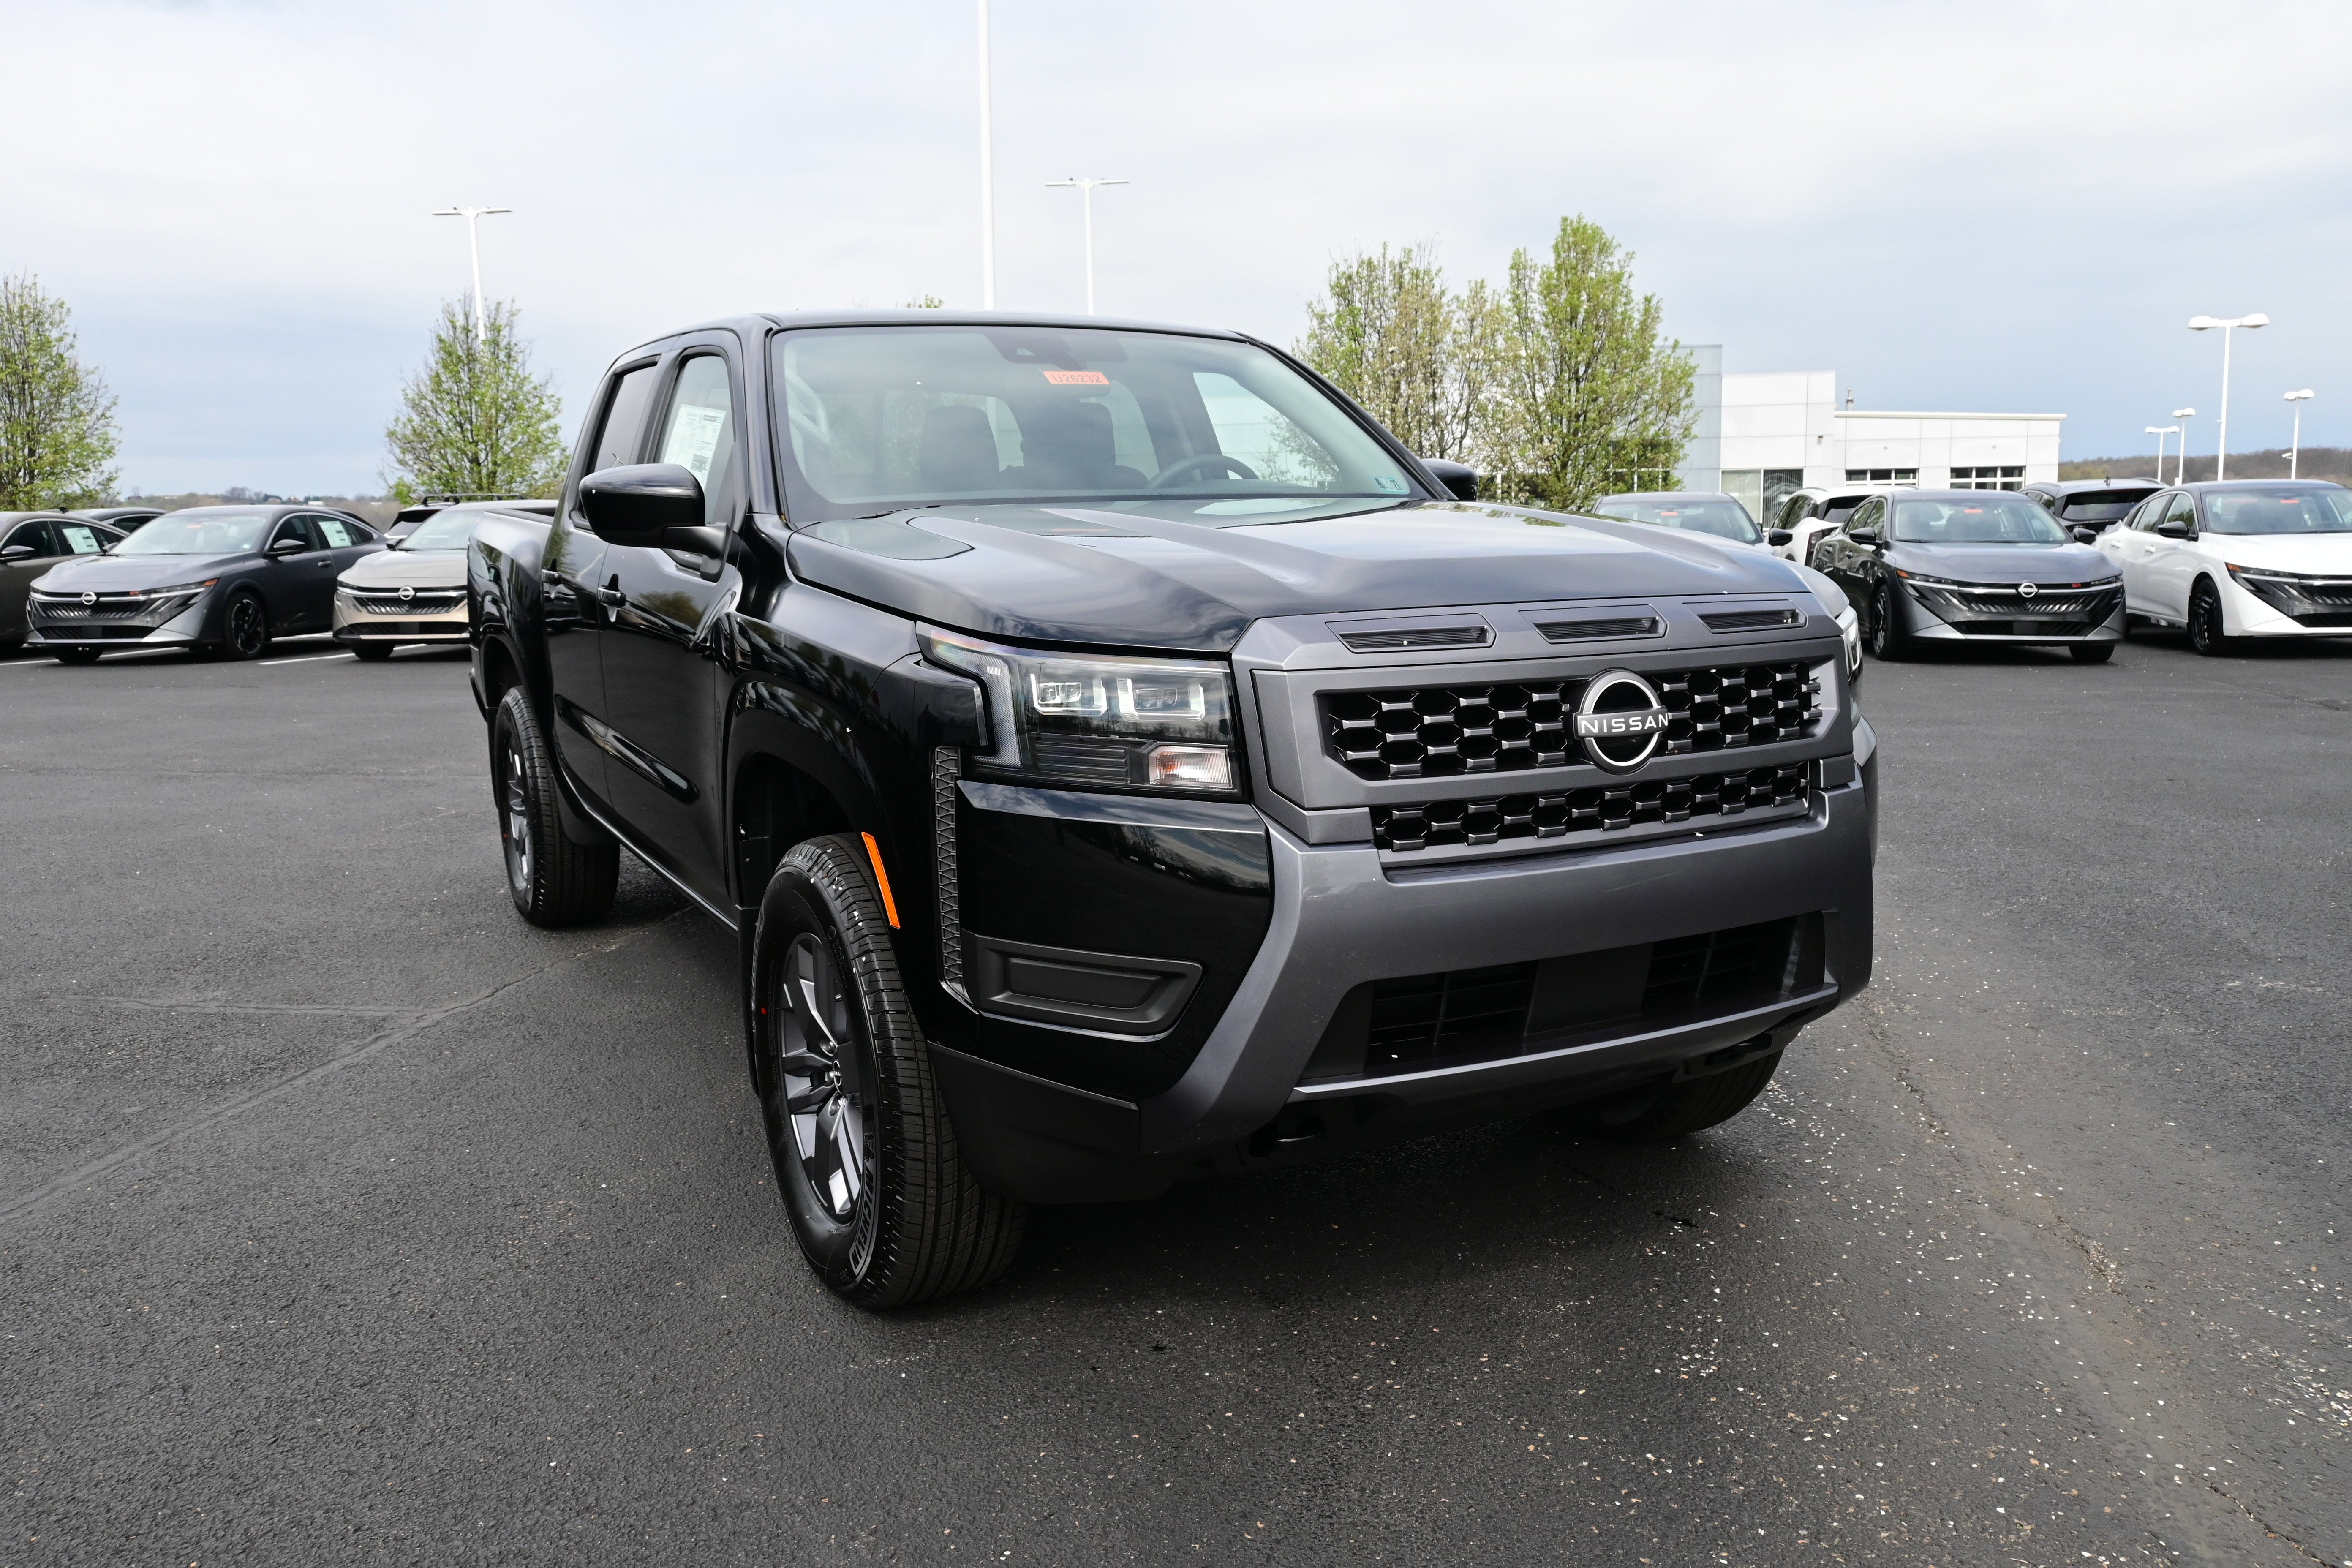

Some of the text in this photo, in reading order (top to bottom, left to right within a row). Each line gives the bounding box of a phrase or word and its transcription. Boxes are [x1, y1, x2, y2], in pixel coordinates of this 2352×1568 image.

[1051, 374, 1103, 383] U26232
[1581, 713, 1669, 734] NISSAN
[851, 1165, 874, 1269] MICHELIN
